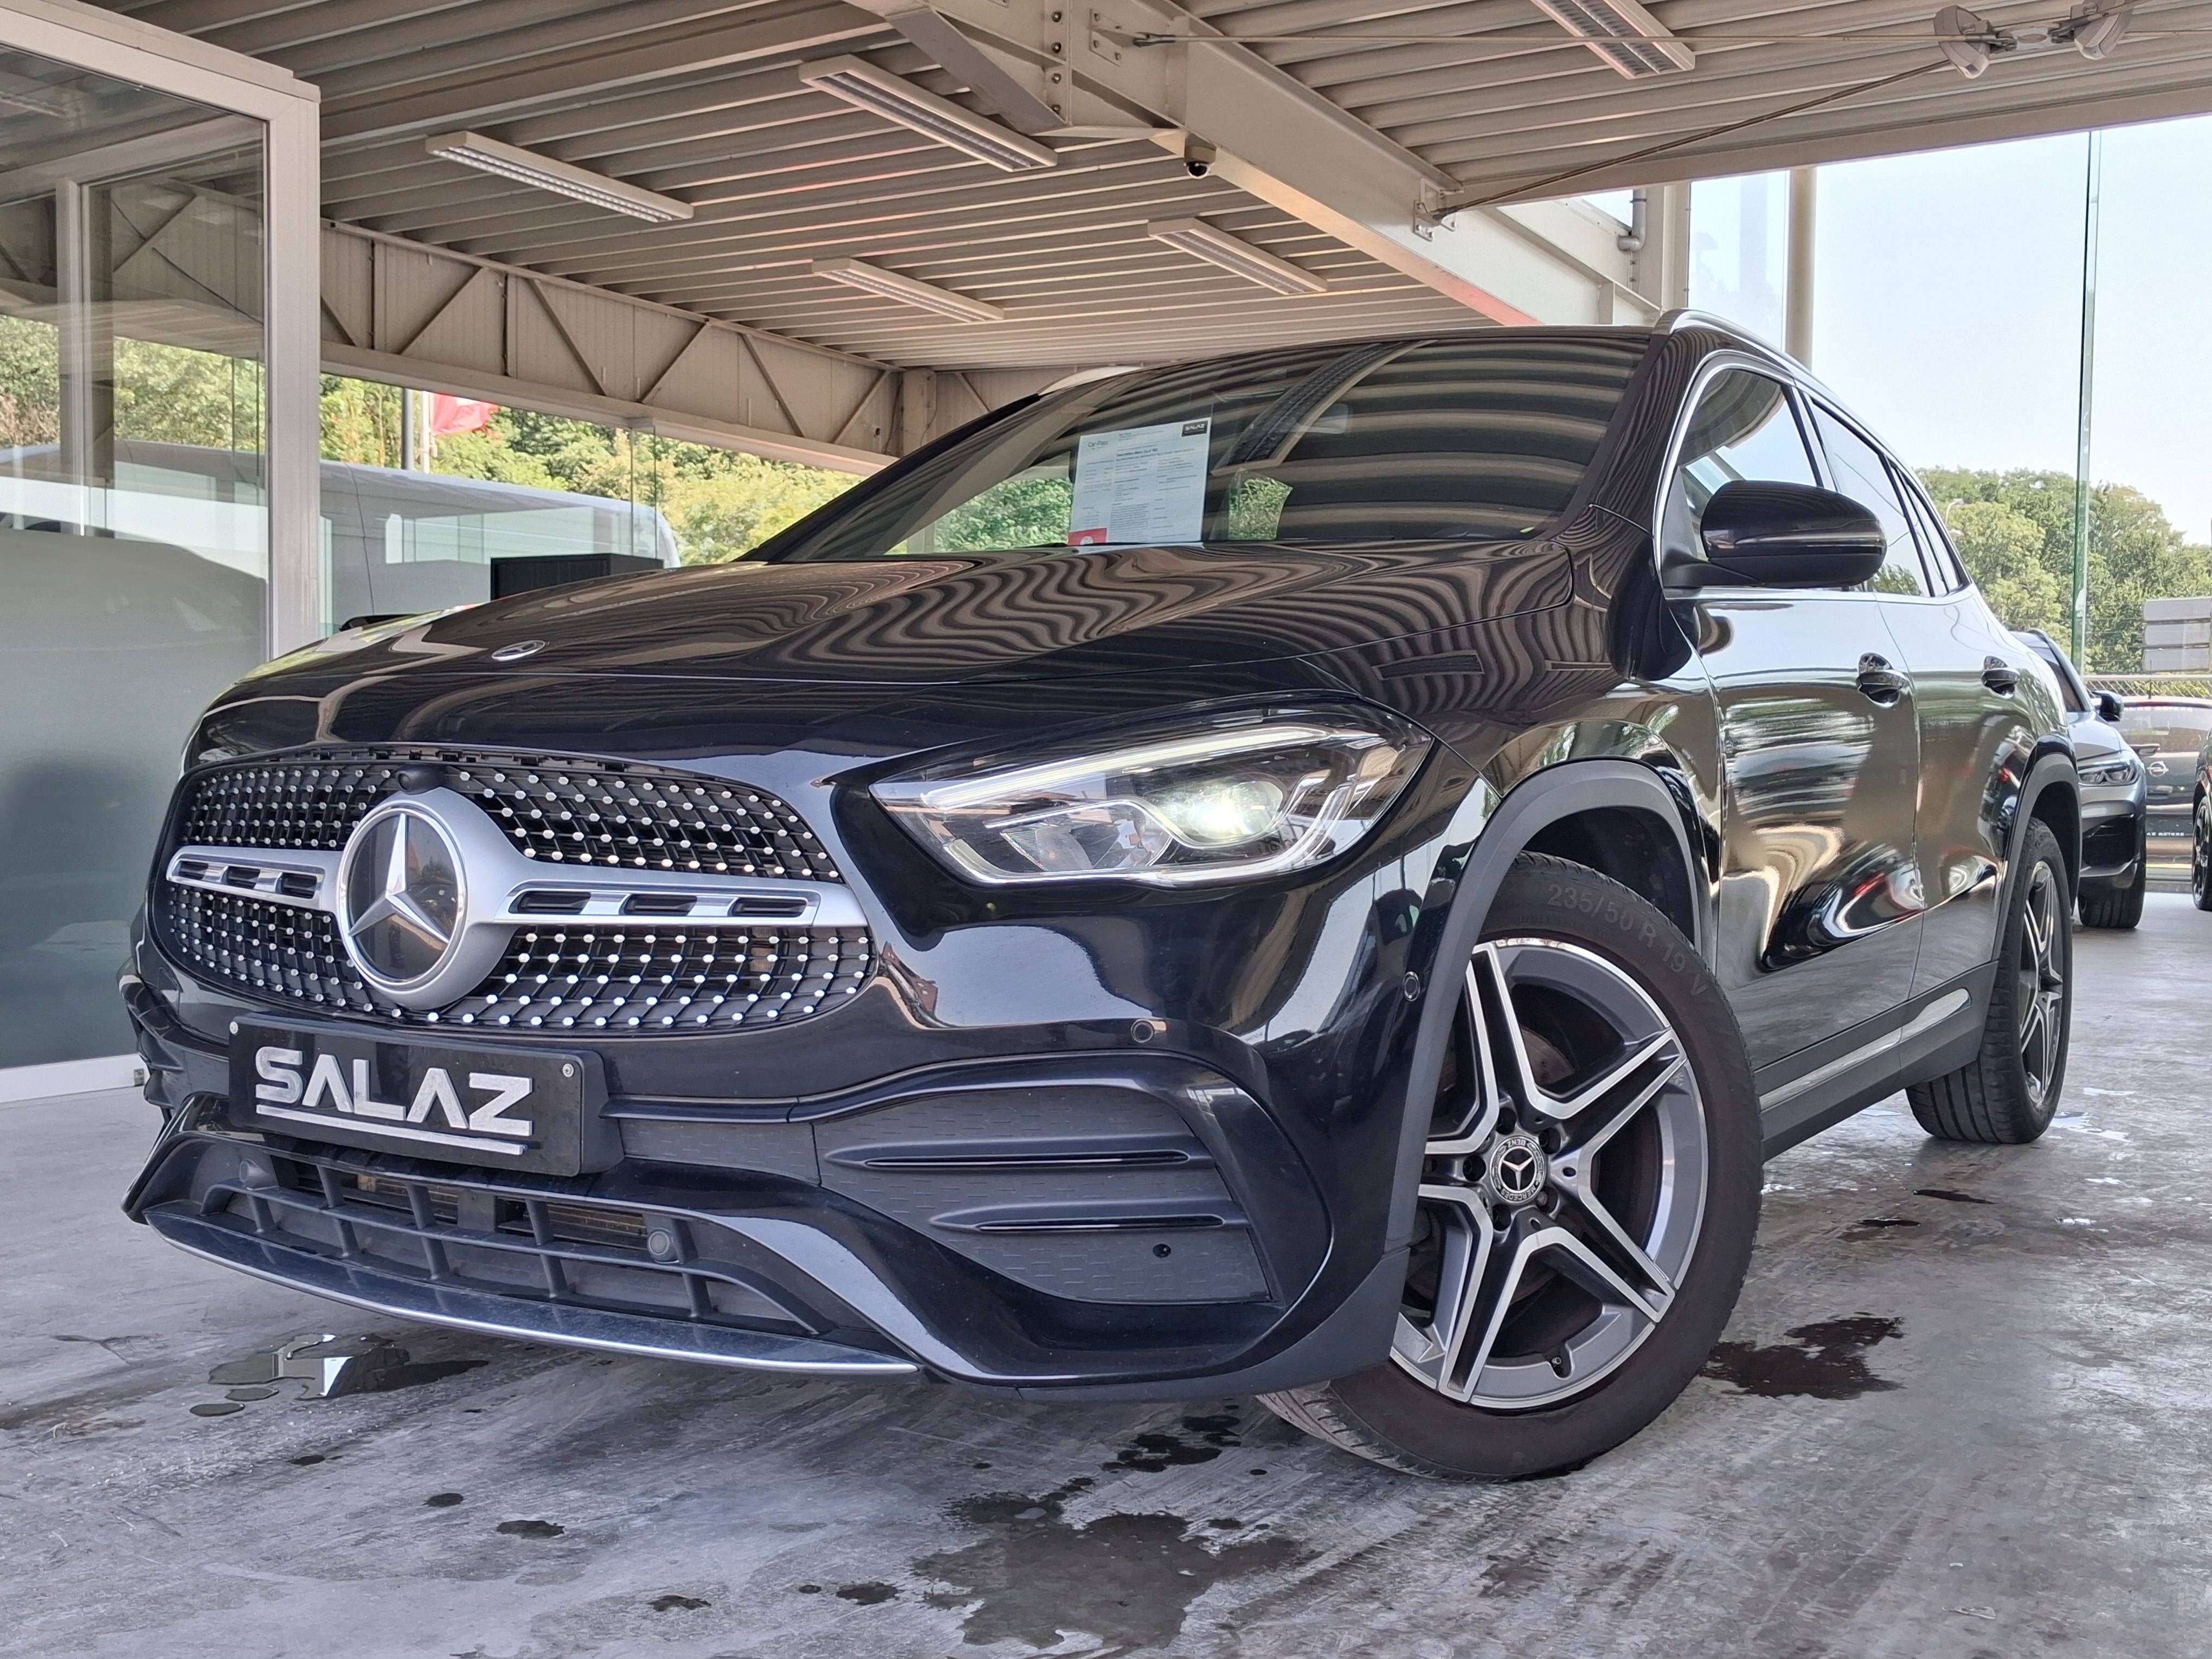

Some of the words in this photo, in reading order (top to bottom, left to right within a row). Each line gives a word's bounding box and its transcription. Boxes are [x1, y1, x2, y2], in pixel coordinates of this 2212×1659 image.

[1548, 884, 1634, 931] 235/50
[1639, 921, 1656, 948] R
[1662, 943, 1687, 973] 19
[1690, 973, 1708, 996] V
[255, 1046, 532, 1136] SALAZ
[1507, 1139, 1527, 1148] BENZ
[1501, 1184, 1536, 1201] MERCEDES
